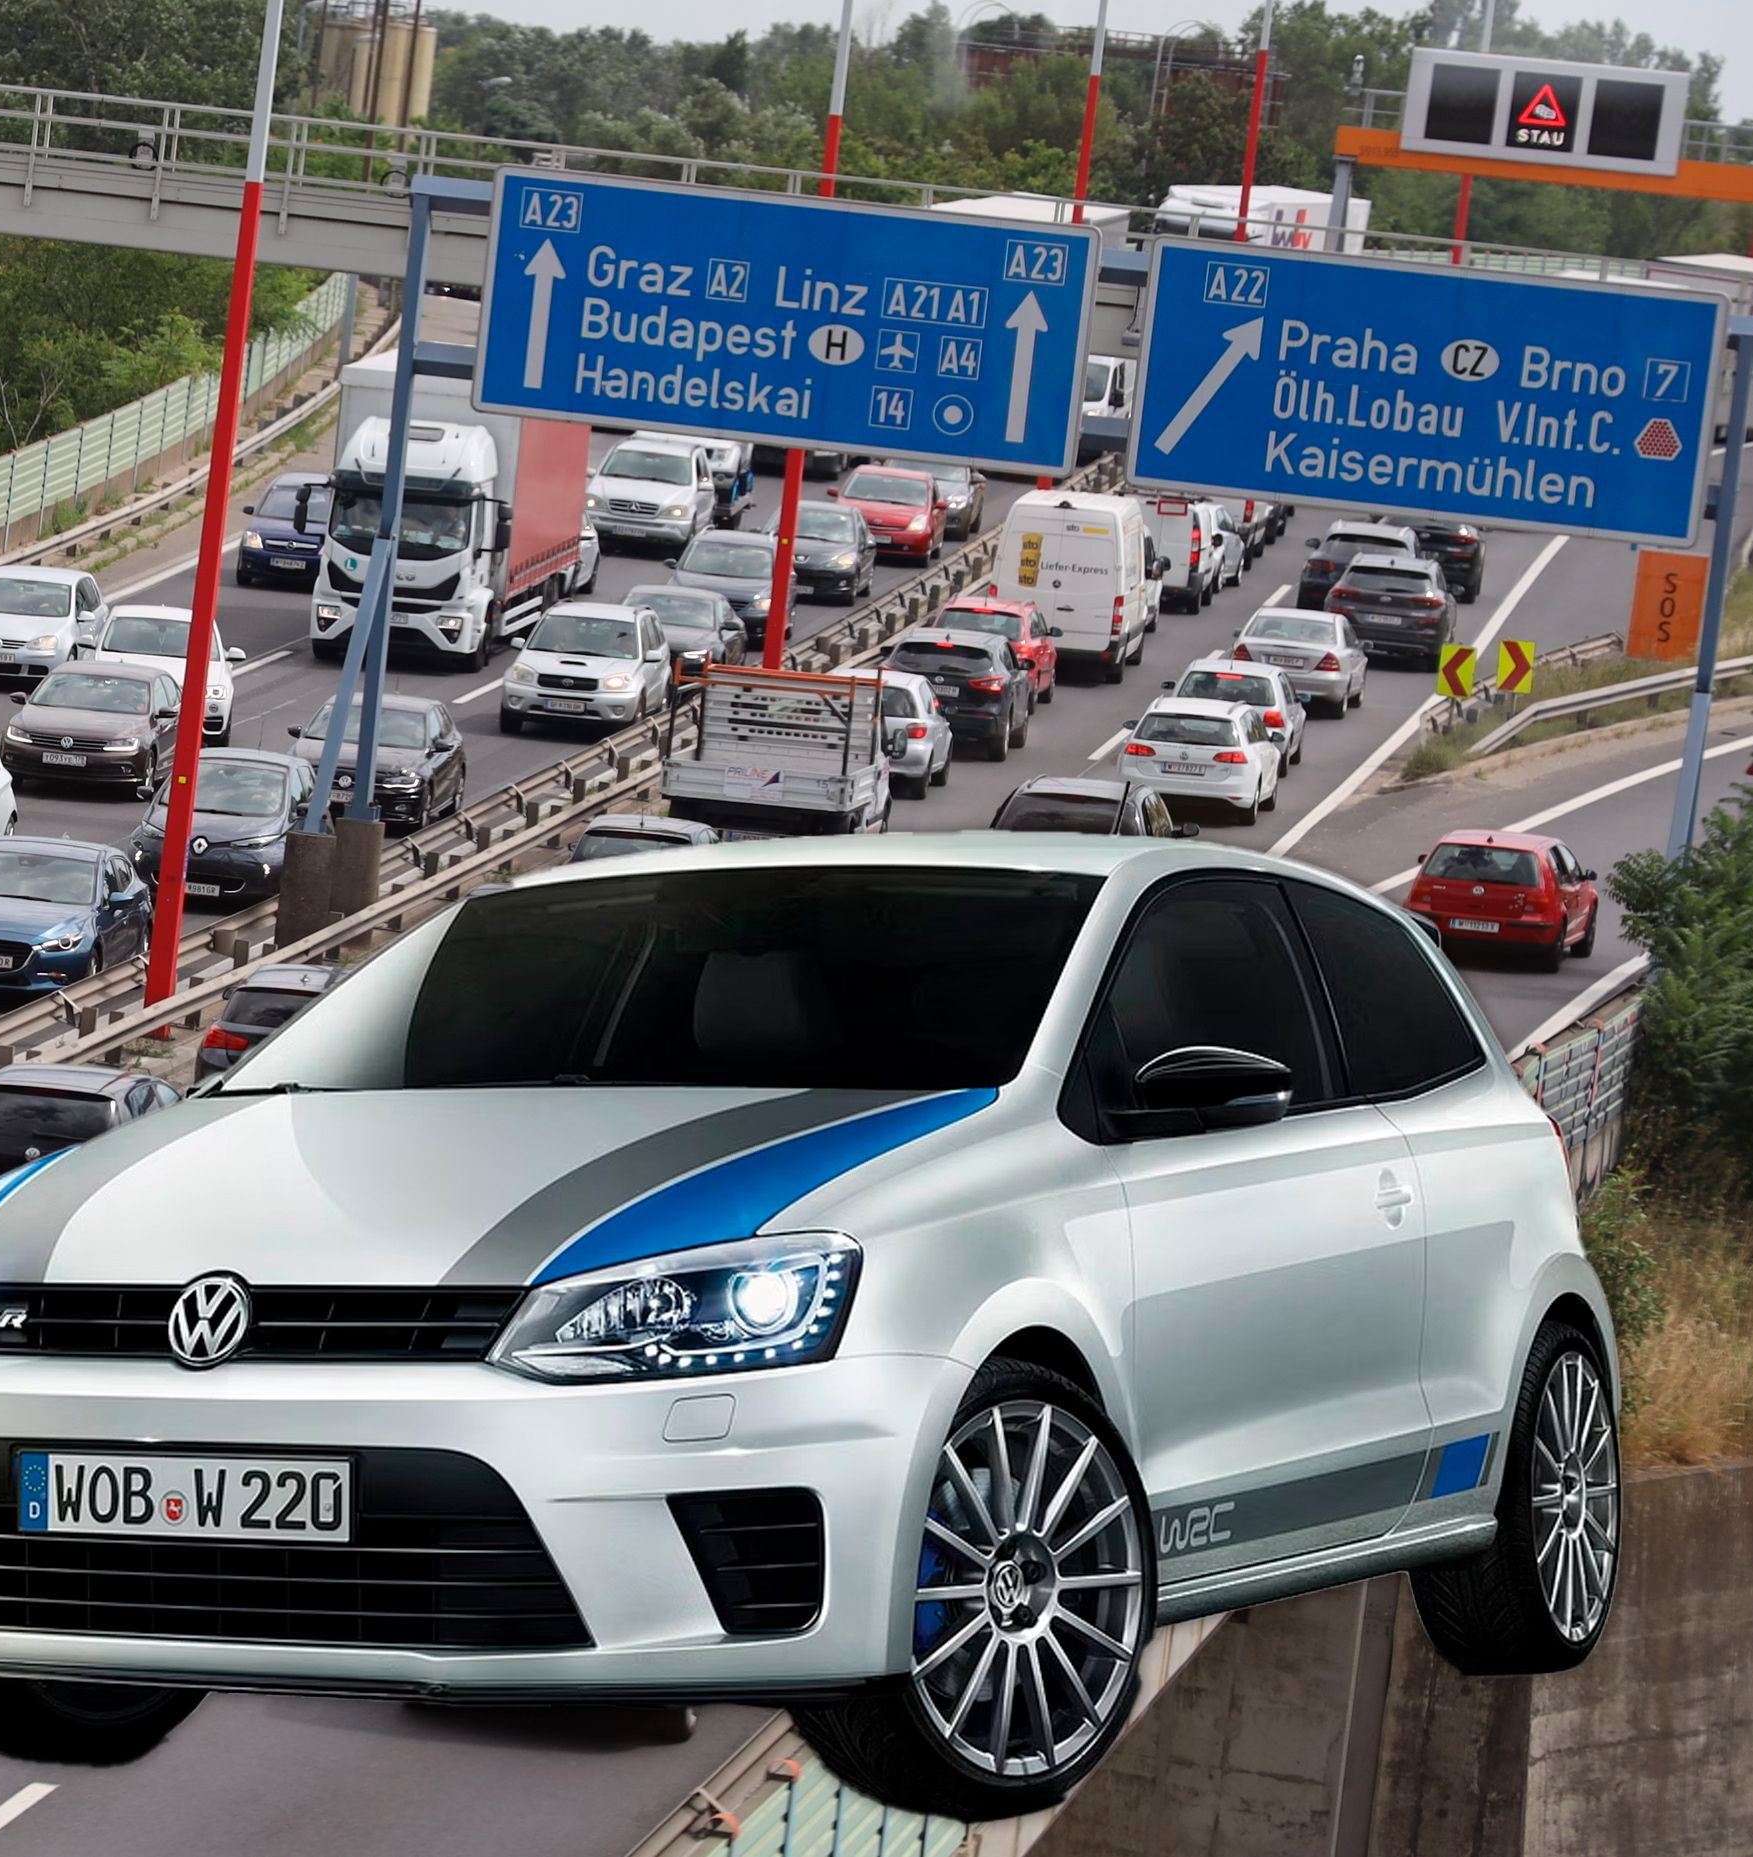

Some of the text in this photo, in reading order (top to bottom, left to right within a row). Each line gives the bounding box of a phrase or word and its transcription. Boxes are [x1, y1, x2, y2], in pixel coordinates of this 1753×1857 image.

[1517, 128, 1565, 147] STAU
[523, 192, 579, 229] A23
[588, 246, 980, 324] Graz A2 Linz A21 A1
[1007, 244, 1064, 281] A23
[1207, 266, 1266, 304] A22
[581, 297, 977, 376] Budapest H A4
[1279, 319, 1680, 398] Praha CZ Brno 7
[576, 352, 905, 425] Handelskai 14
[1274, 370, 1464, 438] Ölh.Lobau
[1266, 430, 1595, 508] Kaisermühlen
[1020, 555, 1037, 567] sto
[1022, 539, 1039, 550] sto
[1040, 561, 1110, 576] Liefer-Express
[1018, 573, 1035, 585] sto
[1656, 572, 1679, 642] SOS
[29, 1464, 343, 1532] D WOB W 220
[1159, 1501, 1235, 1555] WRC
